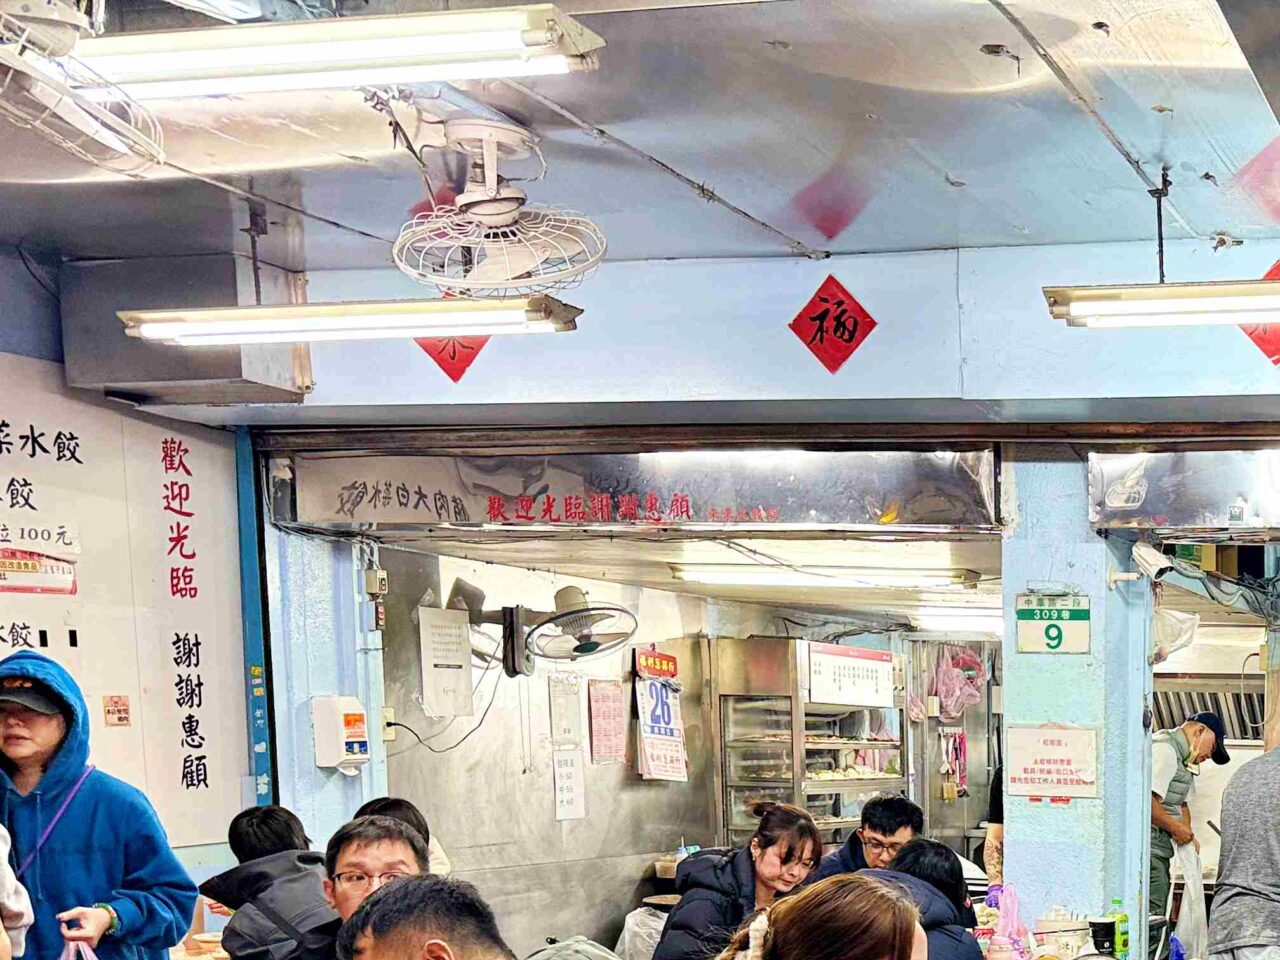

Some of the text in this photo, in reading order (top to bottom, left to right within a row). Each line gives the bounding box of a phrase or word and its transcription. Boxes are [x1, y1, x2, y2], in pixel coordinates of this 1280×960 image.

[807, 295, 859, 346] 福
[486, 491, 692, 523] 歡迎光臨謝謝惠顧
[161, 438, 209, 791] 歡迎光臨 謝謝惠顧
[1044, 623, 1063, 650] 9
[648, 681, 671, 726] 26
